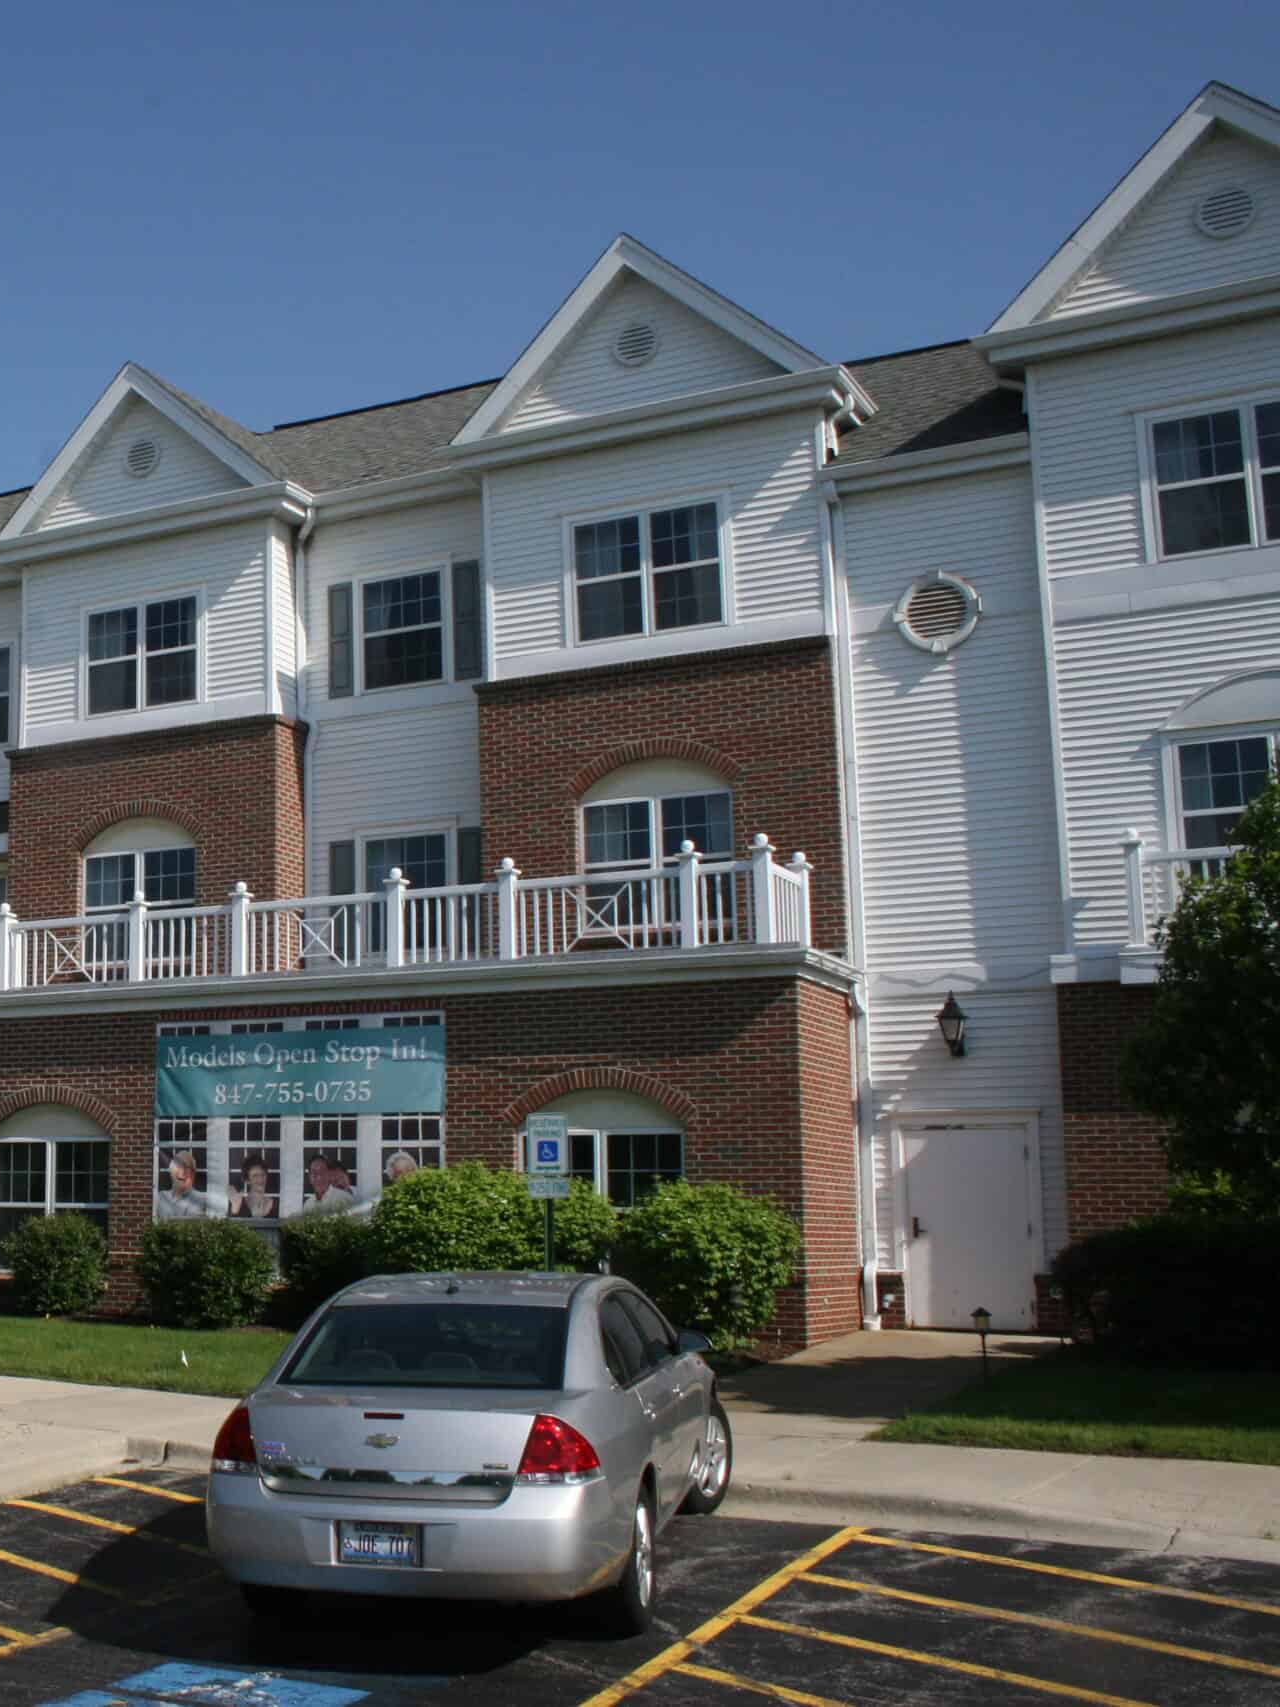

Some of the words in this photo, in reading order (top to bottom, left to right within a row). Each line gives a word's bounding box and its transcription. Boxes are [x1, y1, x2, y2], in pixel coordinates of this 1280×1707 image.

[165, 1044, 246, 1068] Models
[254, 1042, 317, 1073] Open
[325, 1040, 380, 1070] Stop
[391, 1036, 426, 1060] In!
[215, 1079, 371, 1105] 847-755-0735
